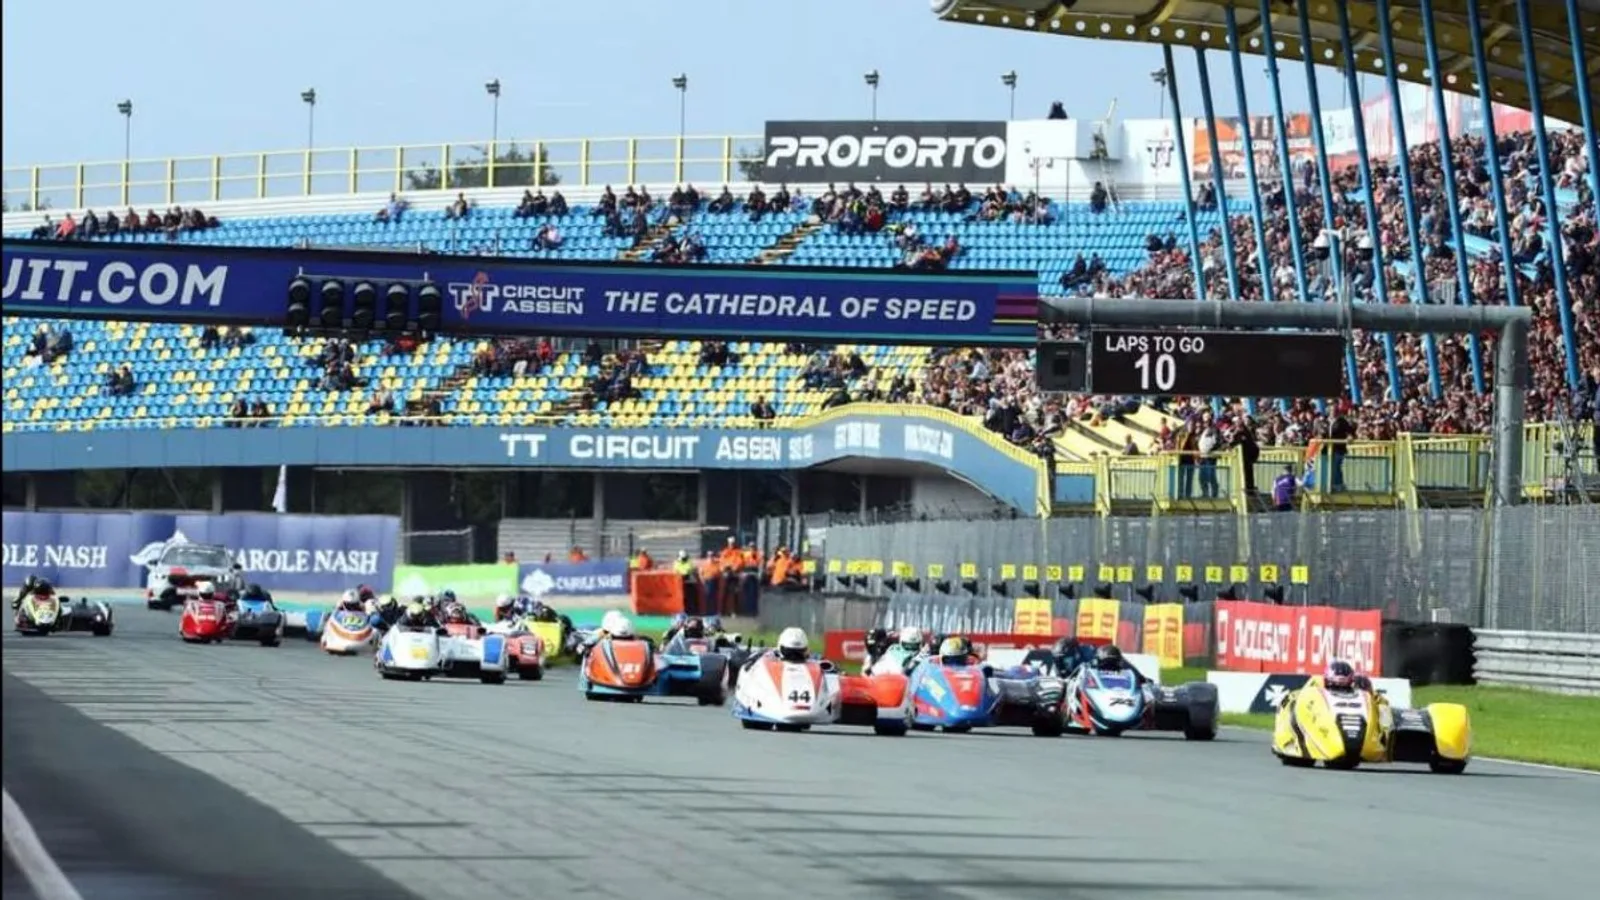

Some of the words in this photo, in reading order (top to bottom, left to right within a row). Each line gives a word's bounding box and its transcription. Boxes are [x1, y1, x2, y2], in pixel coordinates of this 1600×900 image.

[766, 135, 1006, 168] PROFORTO
[502, 285, 585, 300] CIRCUIT
[502, 300, 584, 315] ASSEN
[604, 291, 659, 313] THE
[664, 293, 832, 318] CATHEDRAL
[840, 297, 879, 319] OF
[884, 299, 977, 321] SPEED
[1105, 335, 1149, 352] LAPS
[1153, 336, 1175, 353] TO
[1179, 337, 1205, 353] GO
[1134, 353, 1176, 391] 10
[500, 433, 547, 458] TT
[569, 435, 700, 460] CIRCUIT
[715, 435, 782, 461] ASSEN
[43, 546, 107, 568] NASH
[230, 548, 310, 573] AROLE
[313, 549, 379, 574] NASH
[788, 690, 811, 703] 44
